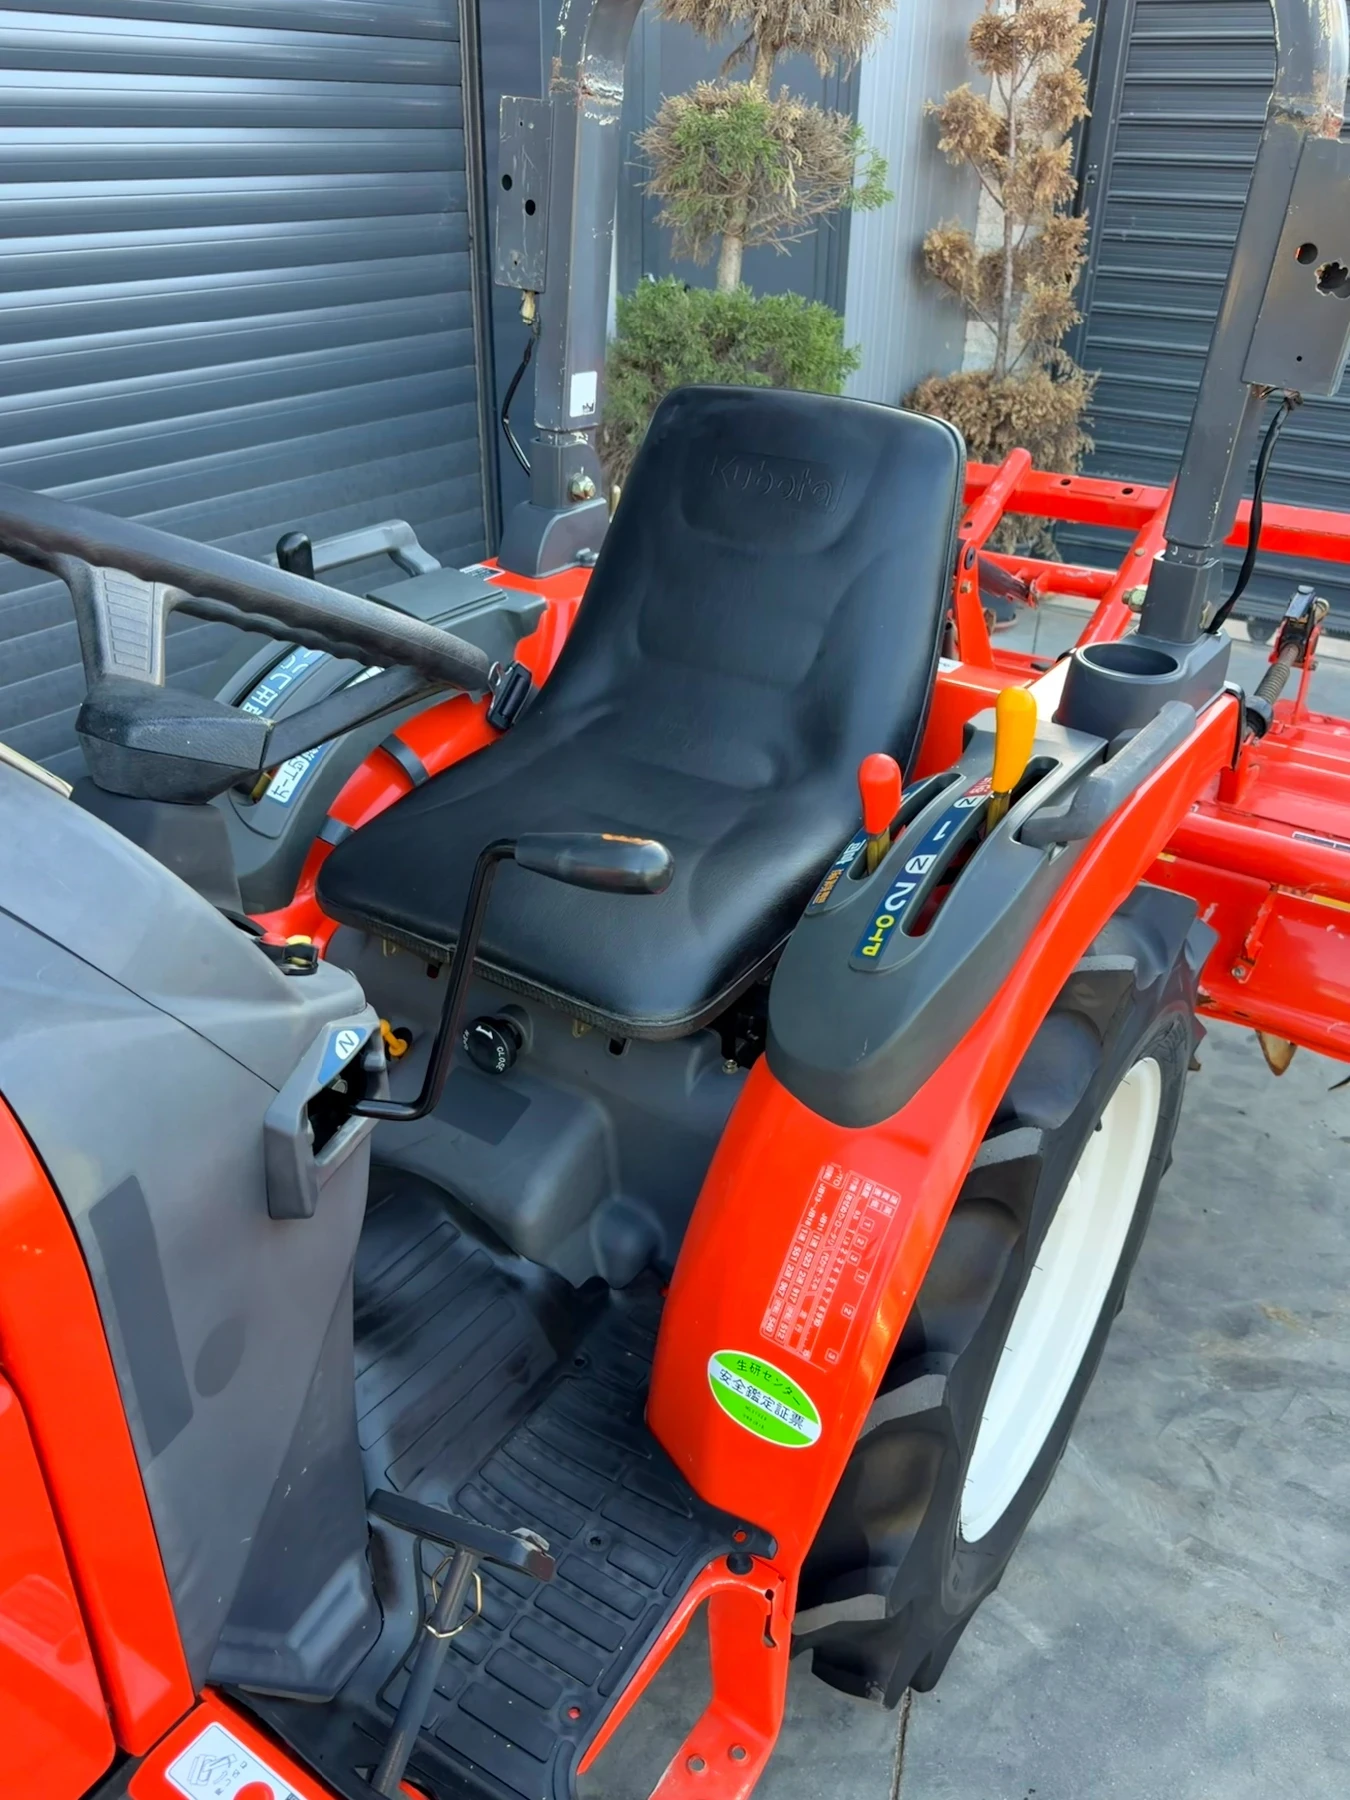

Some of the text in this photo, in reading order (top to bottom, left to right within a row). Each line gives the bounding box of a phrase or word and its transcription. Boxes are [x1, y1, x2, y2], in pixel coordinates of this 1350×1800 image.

[711, 455, 833, 507] Kubota
[862, 915, 895, 956] PTO
[884, 882, 916, 911] 2
[910, 857, 928, 871] N
[933, 820, 951, 841] 1
[338, 1033, 355, 1054] N
[496, 1046, 506, 1072] CLOSE
[801, 1250, 814, 1268] 523
[718, 1368, 805, 1431] 安全鑑定証票
[736, 1358, 801, 1406] 生研センター
